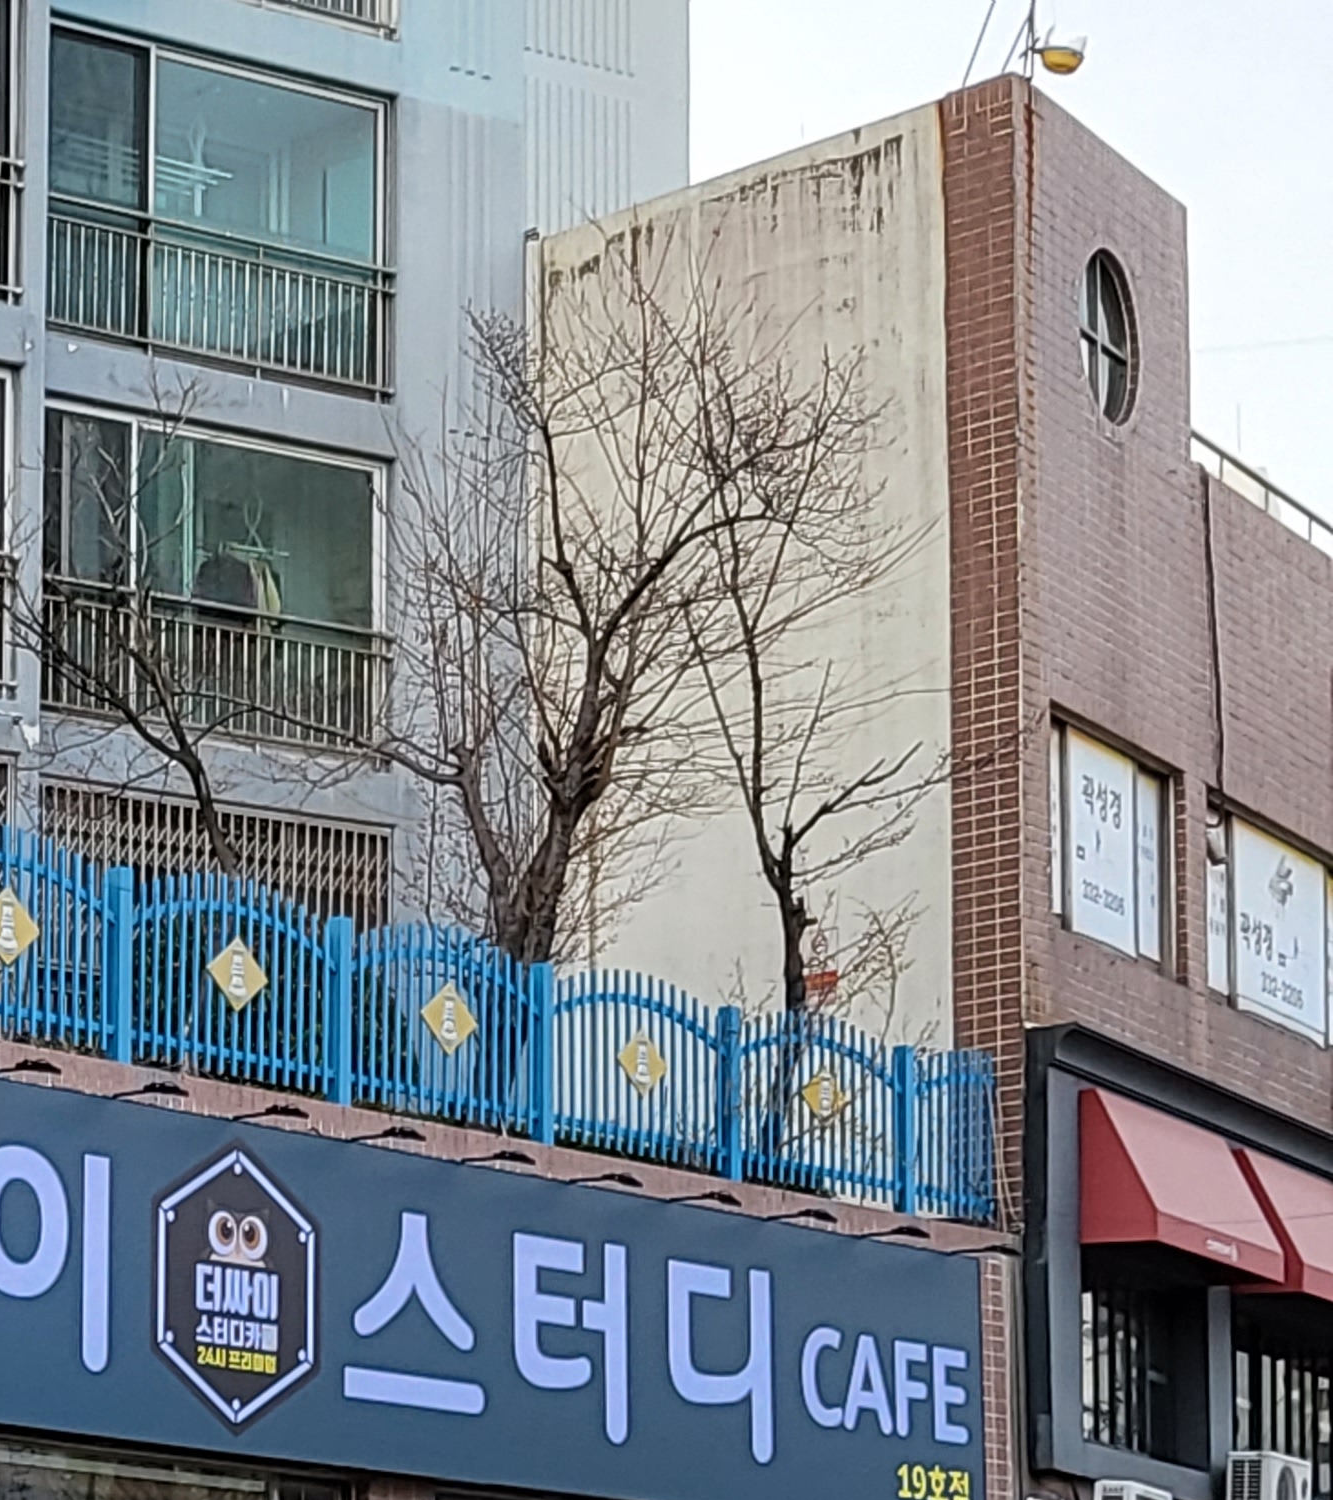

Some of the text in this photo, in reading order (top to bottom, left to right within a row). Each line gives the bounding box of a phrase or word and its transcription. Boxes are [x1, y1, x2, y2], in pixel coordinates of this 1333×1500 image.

[196, 1263, 278, 1321] 더싸이
[197, 1346, 226, 1367] 24시
[343, 1211, 772, 1465] 스터디
[801, 1326, 971, 1446] CAFE
